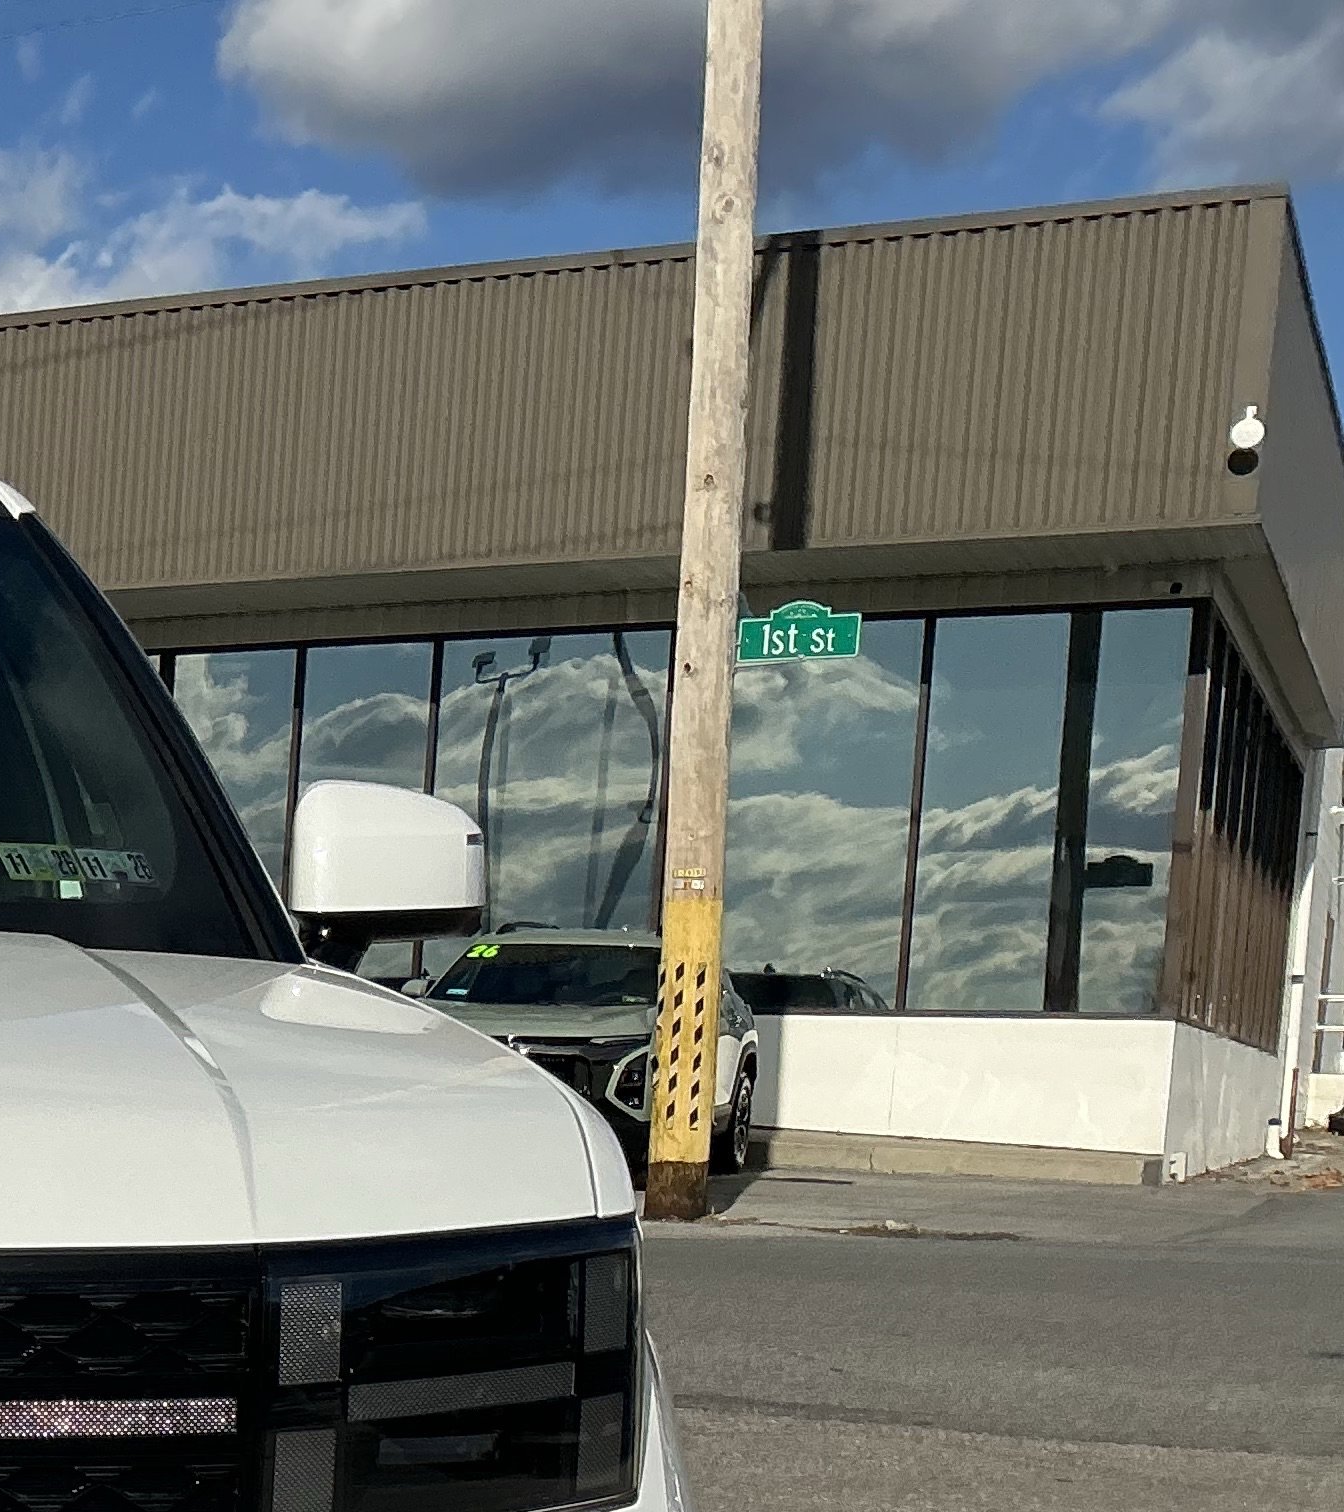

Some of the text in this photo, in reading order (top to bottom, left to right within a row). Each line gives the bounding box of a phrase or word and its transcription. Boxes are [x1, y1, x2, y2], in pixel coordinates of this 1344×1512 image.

[762, 623, 836, 656] 1st St
[466, 944, 501, 958] 26
